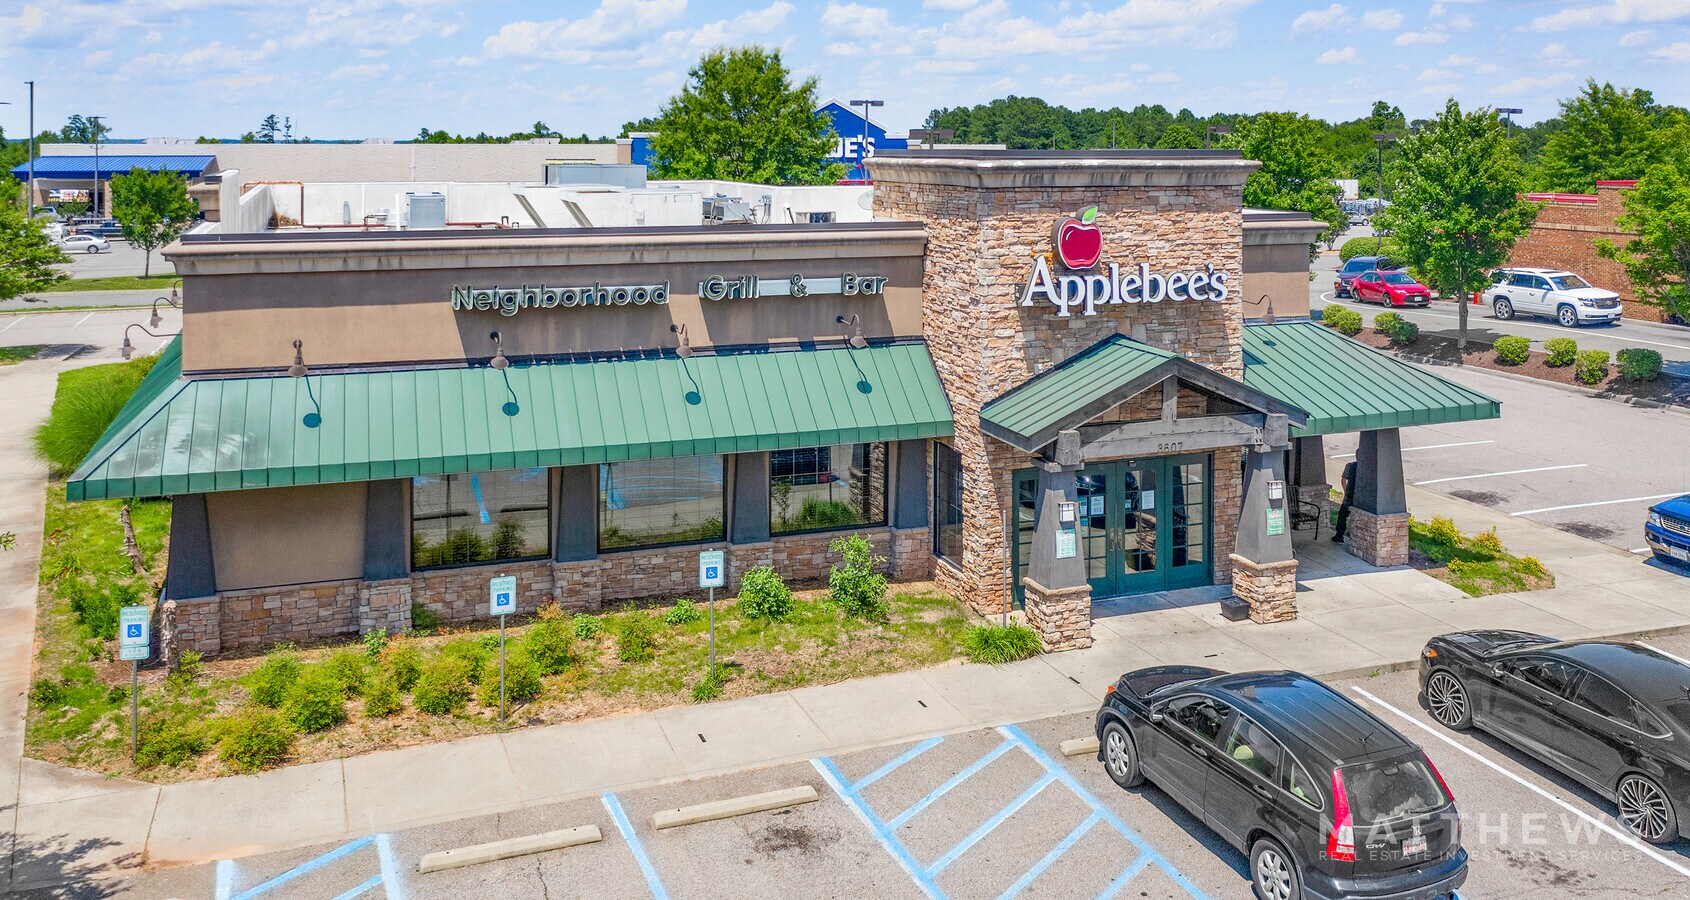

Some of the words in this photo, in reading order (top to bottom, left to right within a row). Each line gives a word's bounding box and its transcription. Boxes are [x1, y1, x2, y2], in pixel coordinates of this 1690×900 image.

[451, 280, 670, 317] Neighborhood
[703, 274, 761, 300] Grill
[789, 273, 809, 297] &
[841, 272, 888, 295] Bar
[1020, 254, 1229, 317] Applebee's
